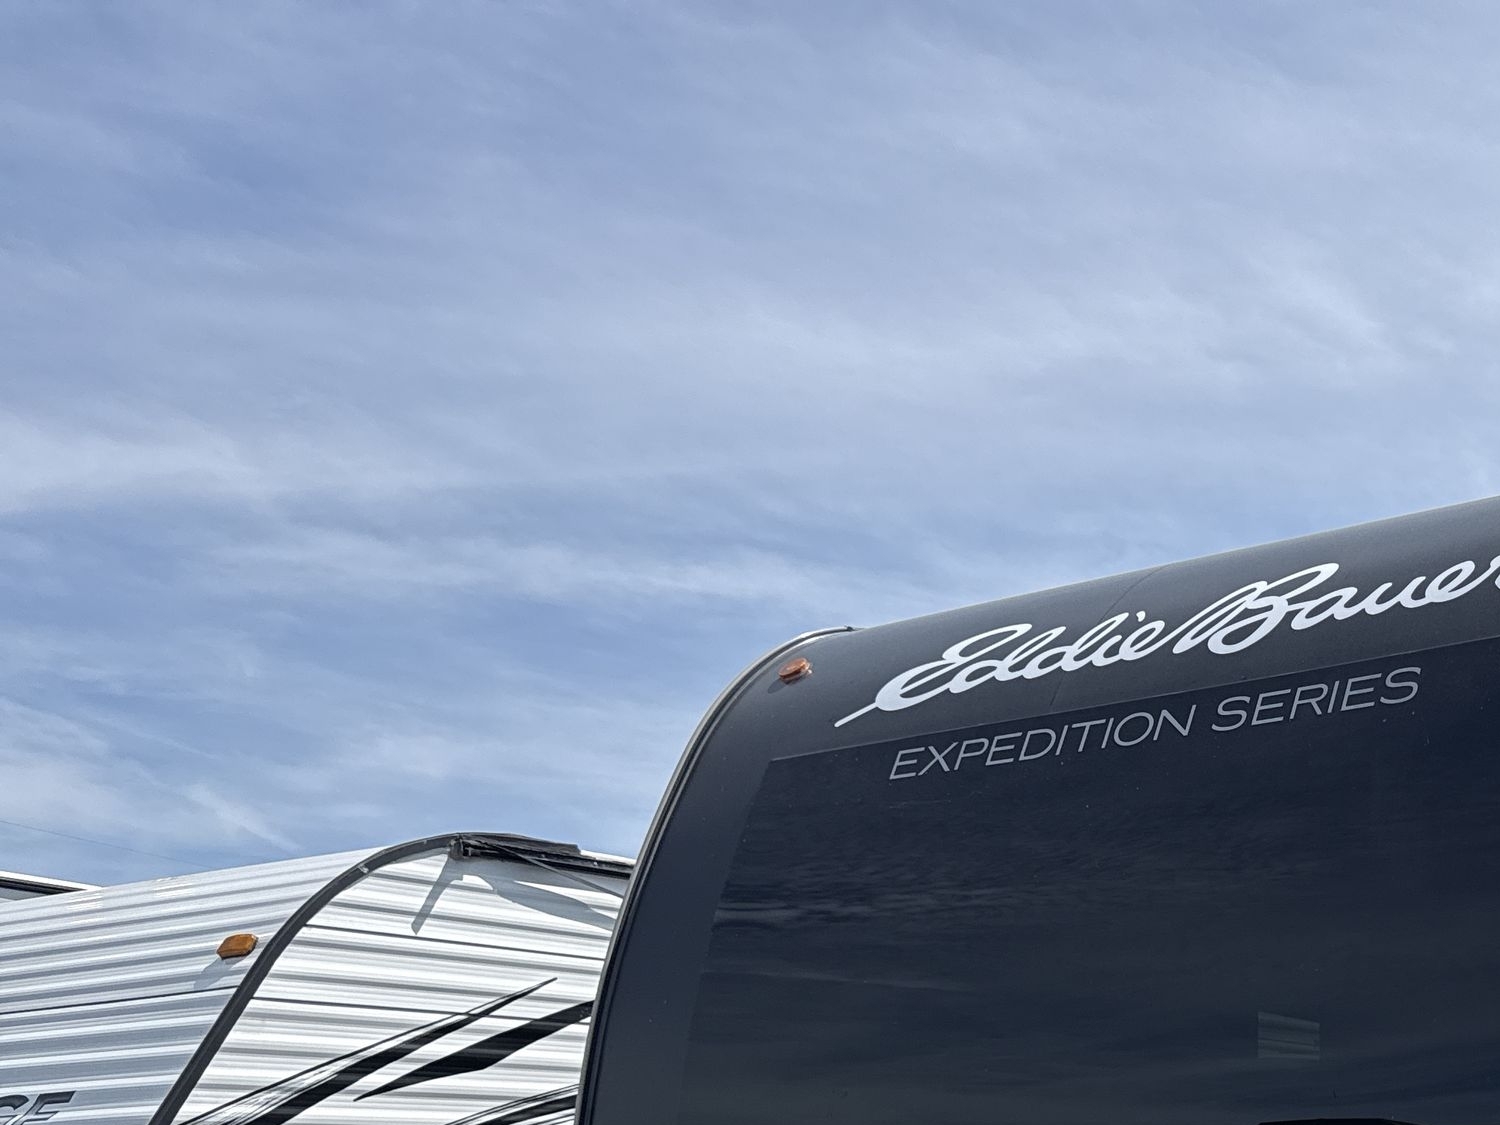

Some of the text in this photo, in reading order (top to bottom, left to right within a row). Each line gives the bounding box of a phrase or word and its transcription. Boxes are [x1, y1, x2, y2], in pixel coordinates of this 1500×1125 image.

[834, 610, 1176, 727] Eddie
[889, 666, 1422, 781] EXPEDITION SERIES
